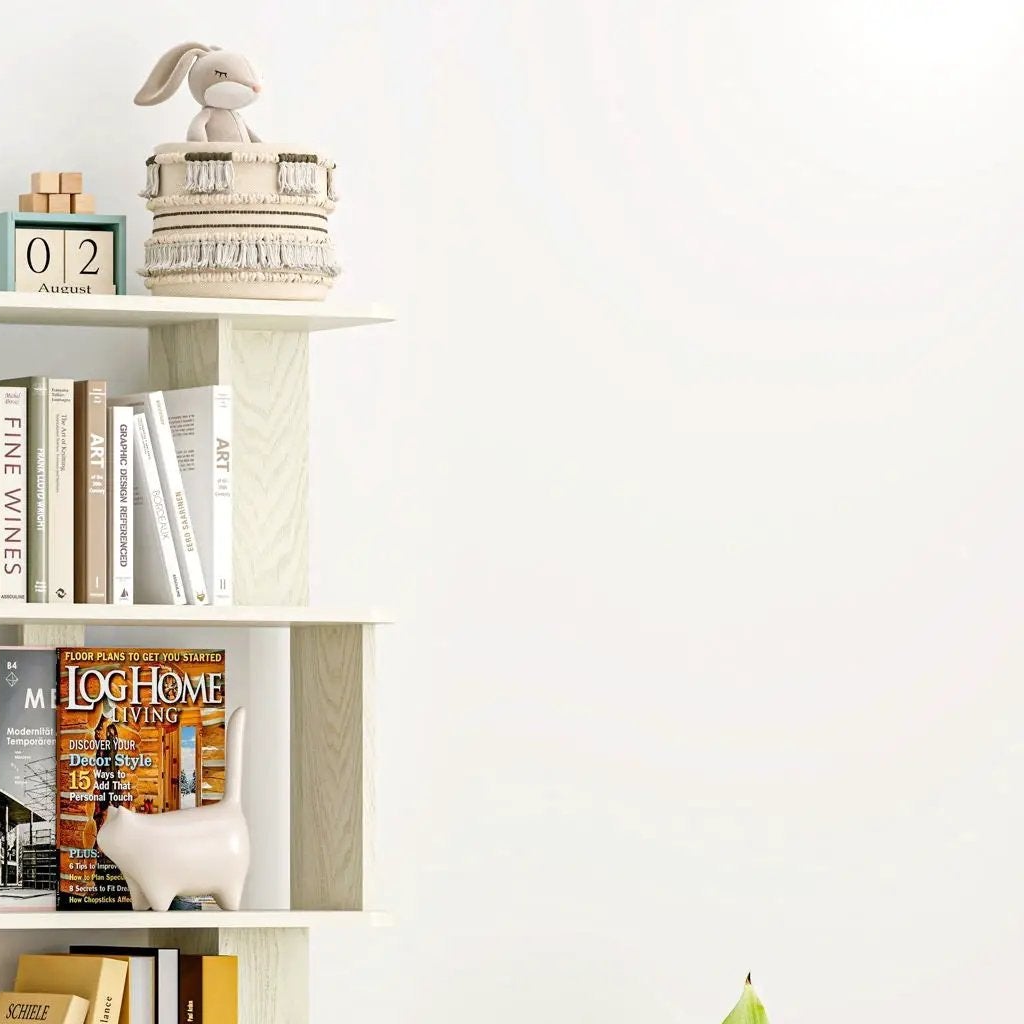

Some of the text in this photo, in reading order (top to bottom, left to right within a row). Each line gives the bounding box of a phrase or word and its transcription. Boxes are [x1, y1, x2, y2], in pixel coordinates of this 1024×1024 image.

[78, 239, 100, 274] 2
[38, 283, 92, 294] August
[4, 417, 22, 475] FINE
[90, 433, 105, 469] ART
[119, 424, 128, 466] GRAPHIC
[216, 438, 230, 472] ART
[119, 468, 128, 503] DESIGN
[37, 501, 46, 531] WRIGHT
[175, 491, 194, 552] EERO SAARINEN
[4, 487, 22, 575] WINES
[119, 506, 128, 568] REFERENCED
[65, 652, 222, 662] FLOOR PLANS TO GET YOU STARTED
[112, 706, 178, 723] LIVING
[6, 727, 54, 736] Modernität
[6, 737, 56, 746] Temporären
[69, 740, 136, 750] DISCOVER YOUR
[69, 753, 152, 770] Decor Style
[69, 770, 91, 790] 15
[93, 770, 126, 780] Ways to
[93, 781, 131, 790] Add That
[69, 792, 133, 802] Personal Touch
[69, 848, 100, 858] PLUS:
[84, 896, 116, 904] Chopsticks
[6, 1003, 50, 1021] SCHIELE
